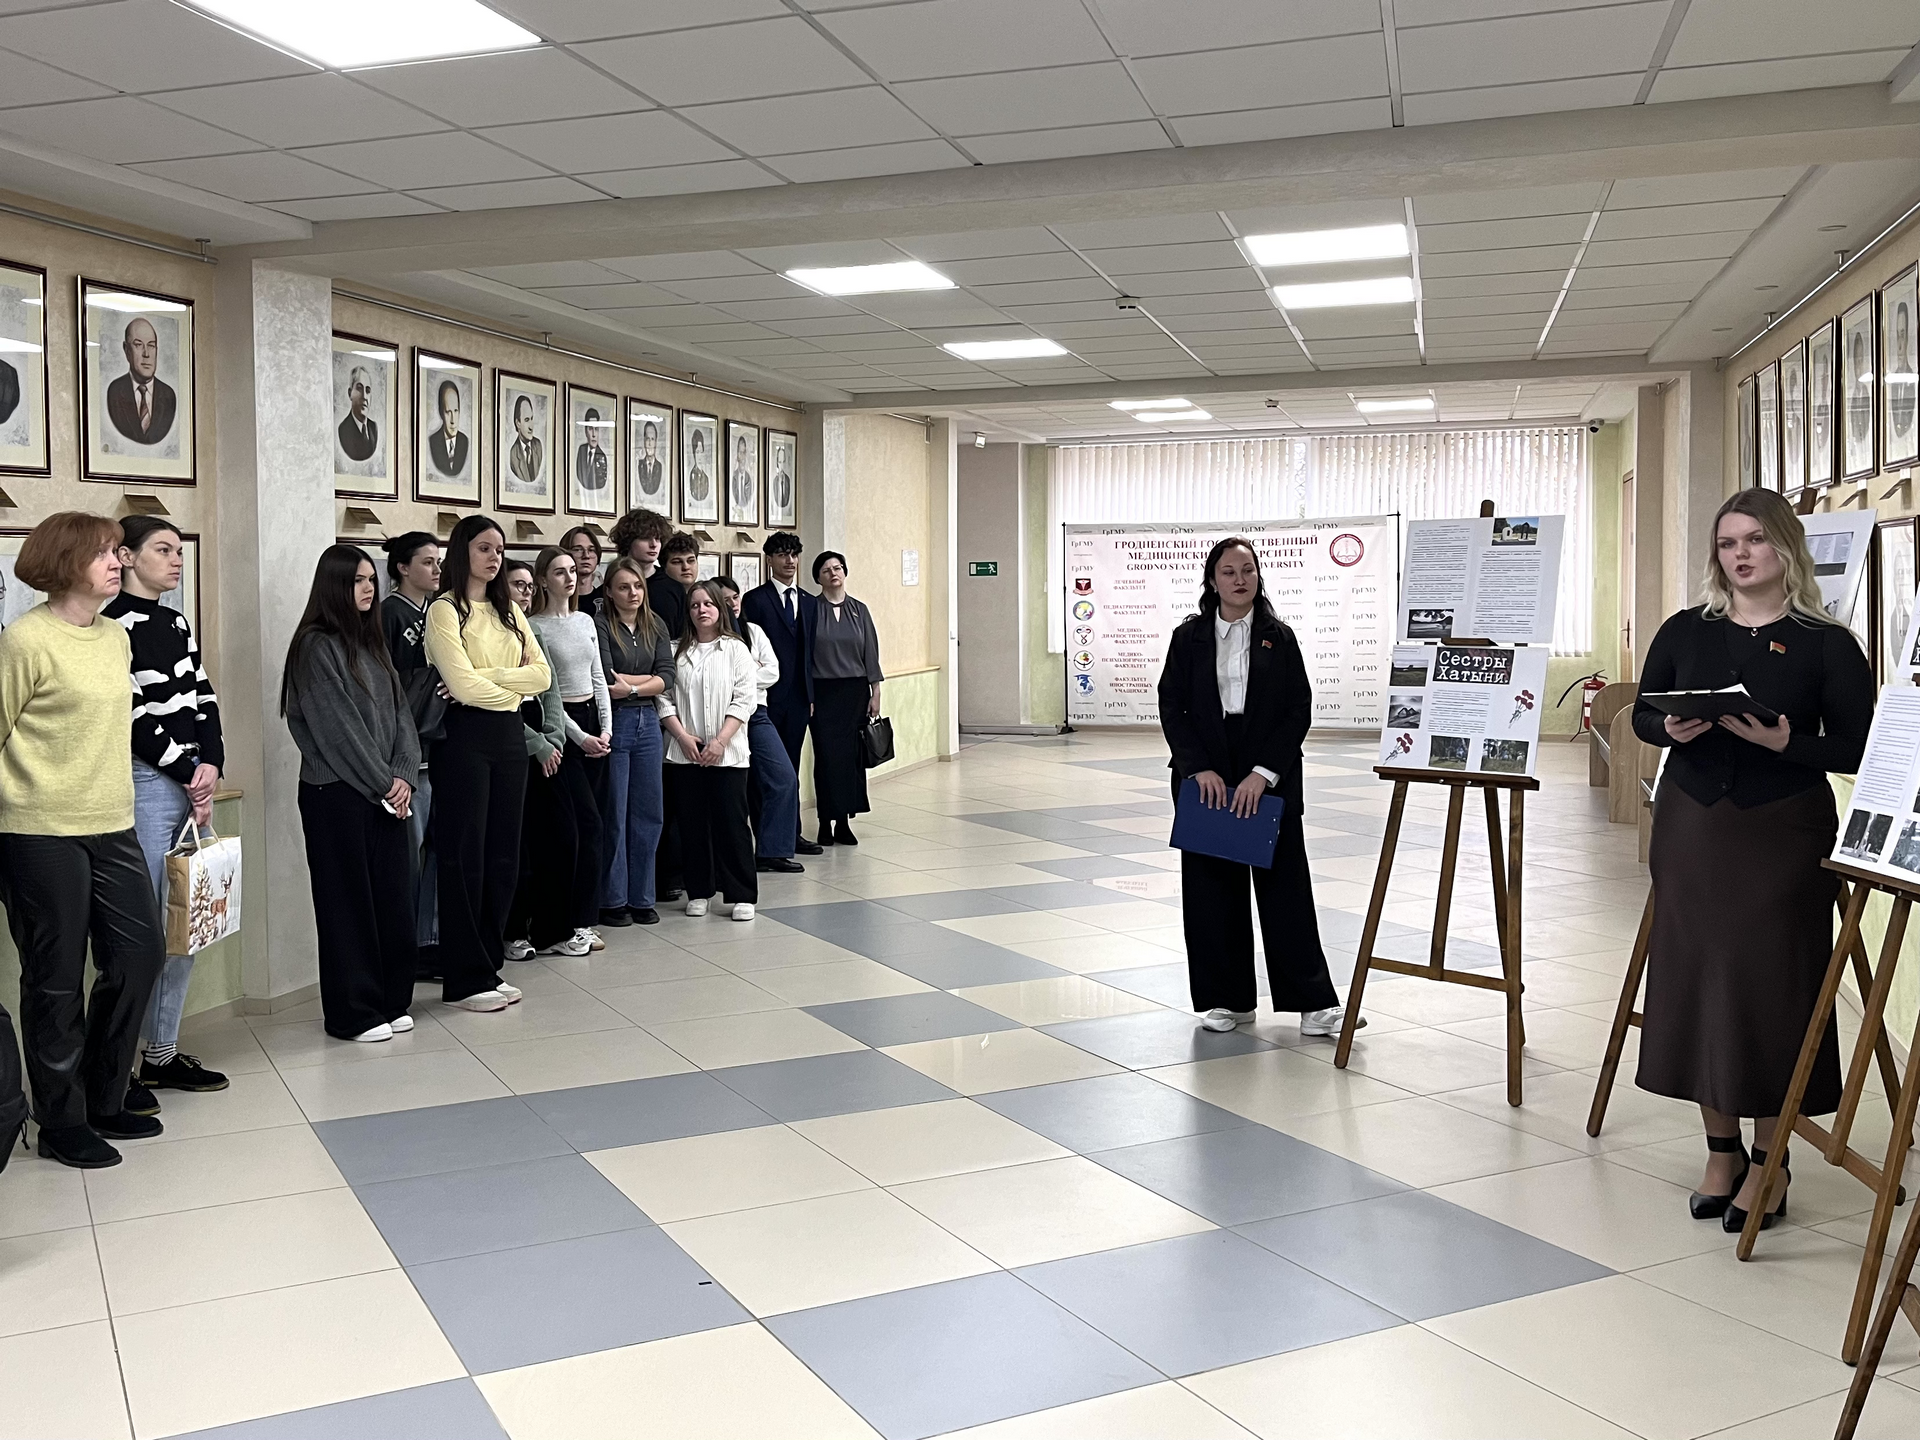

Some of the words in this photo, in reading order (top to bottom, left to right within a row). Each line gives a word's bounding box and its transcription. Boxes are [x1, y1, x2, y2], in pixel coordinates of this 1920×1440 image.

[1241, 525, 1267, 533] ГрГМУ
[1313, 523, 1340, 531] ГрГМУ
[1114, 539, 1197, 550] ГРОДНЕНСКИЙ
[1128, 551, 1208, 561] МЕДИЦИНСКИ
[1126, 563, 1168, 571] GRODNO
[1168, 563, 1197, 571] STATE
[1260, 560, 1305, 569] IVERSITY
[1439, 650, 1508, 671] Сестры
[1436, 665, 1509, 684] Хатыни.
[1316, 703, 1341, 711] ГрГМУ
[1353, 717, 1379, 725] ГрГМУ
